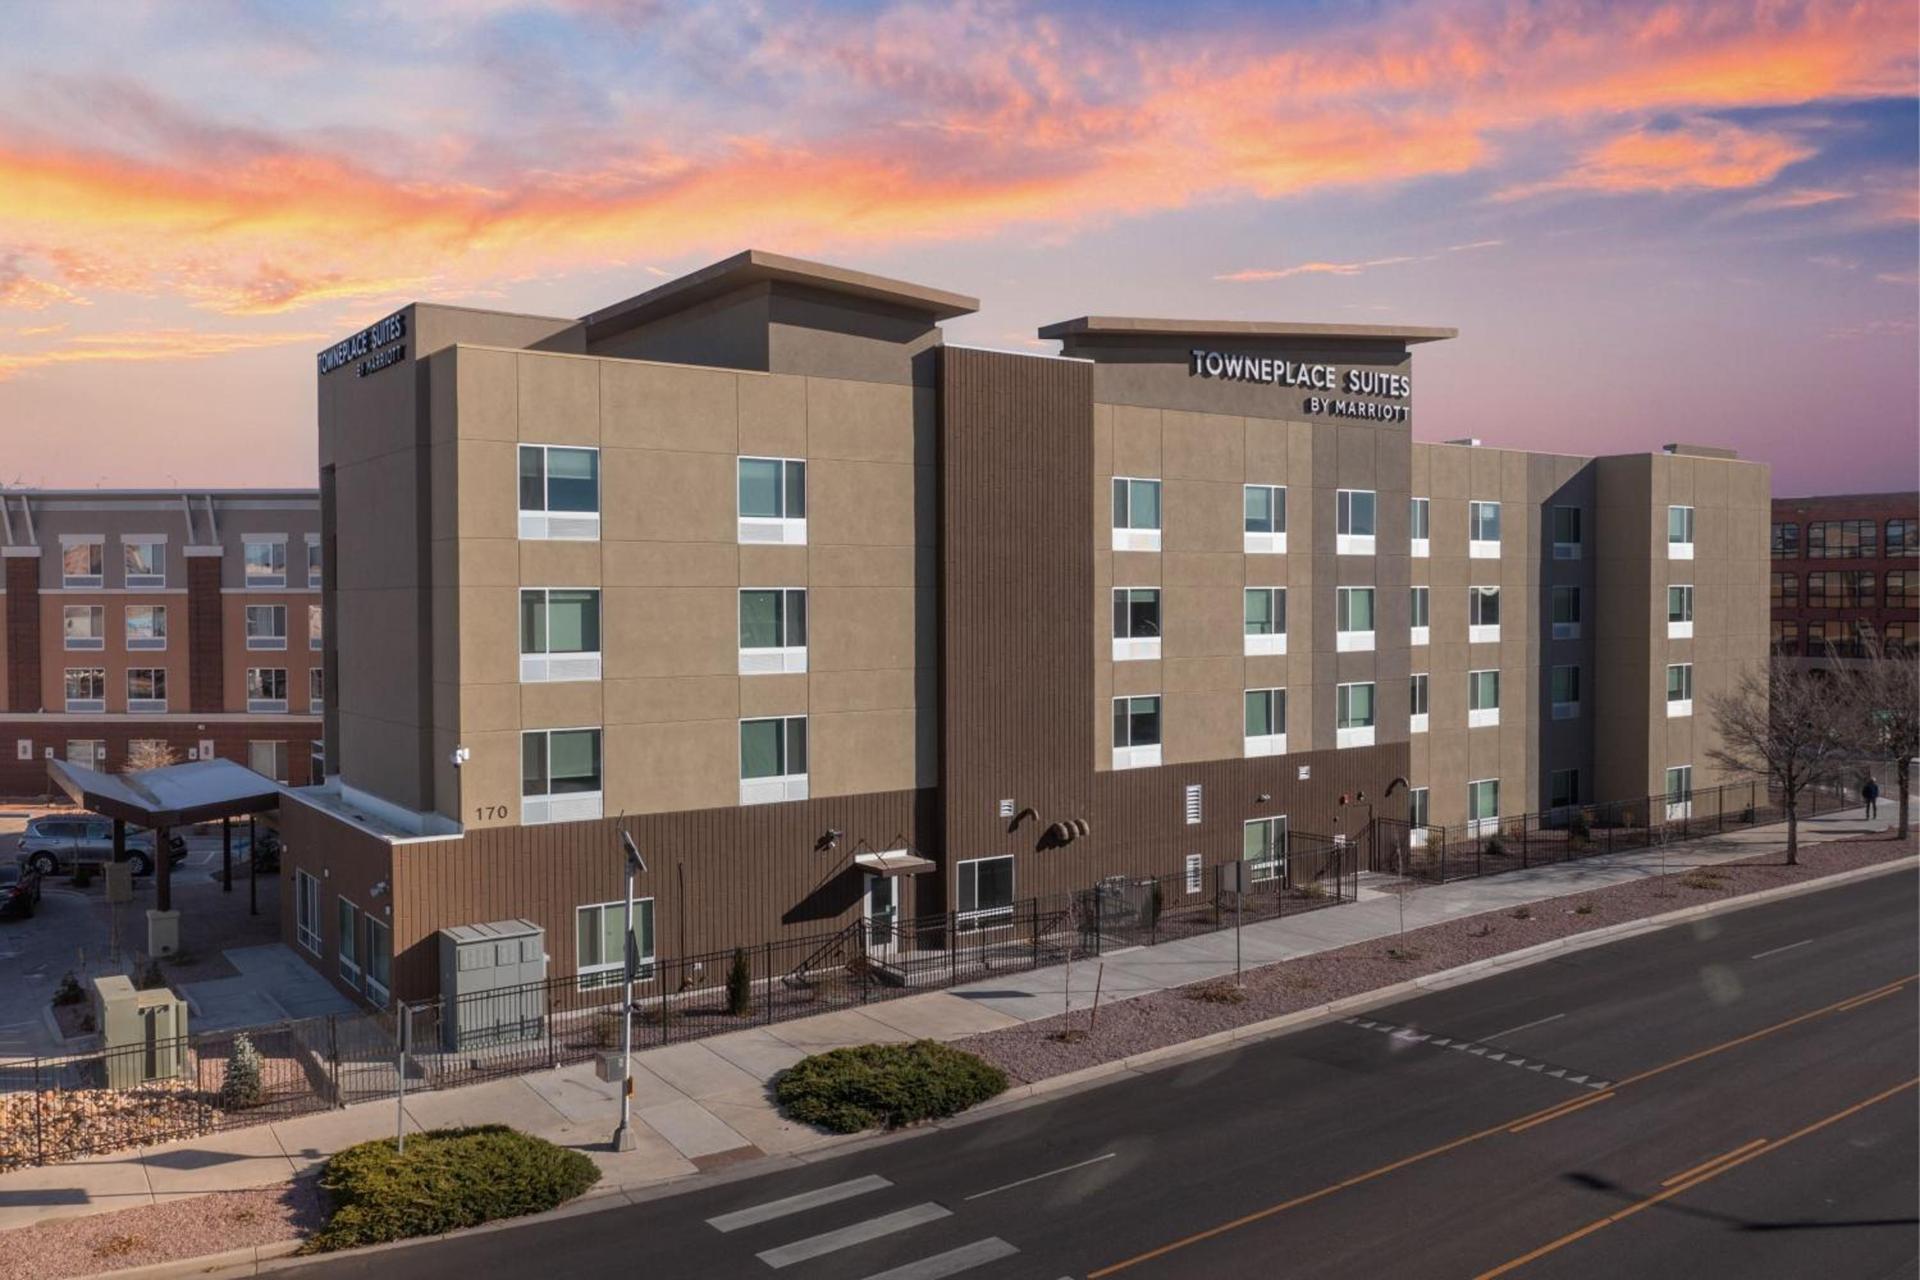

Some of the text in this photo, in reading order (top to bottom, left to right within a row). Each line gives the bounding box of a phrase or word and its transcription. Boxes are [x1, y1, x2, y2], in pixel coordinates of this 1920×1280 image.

[371, 314, 402, 349] SUITES
[1192, 350, 1410, 397] TOWNEPLACE SUITES
[1310, 397, 1411, 421] BY MARRIOTT
[475, 805, 508, 821] 170
